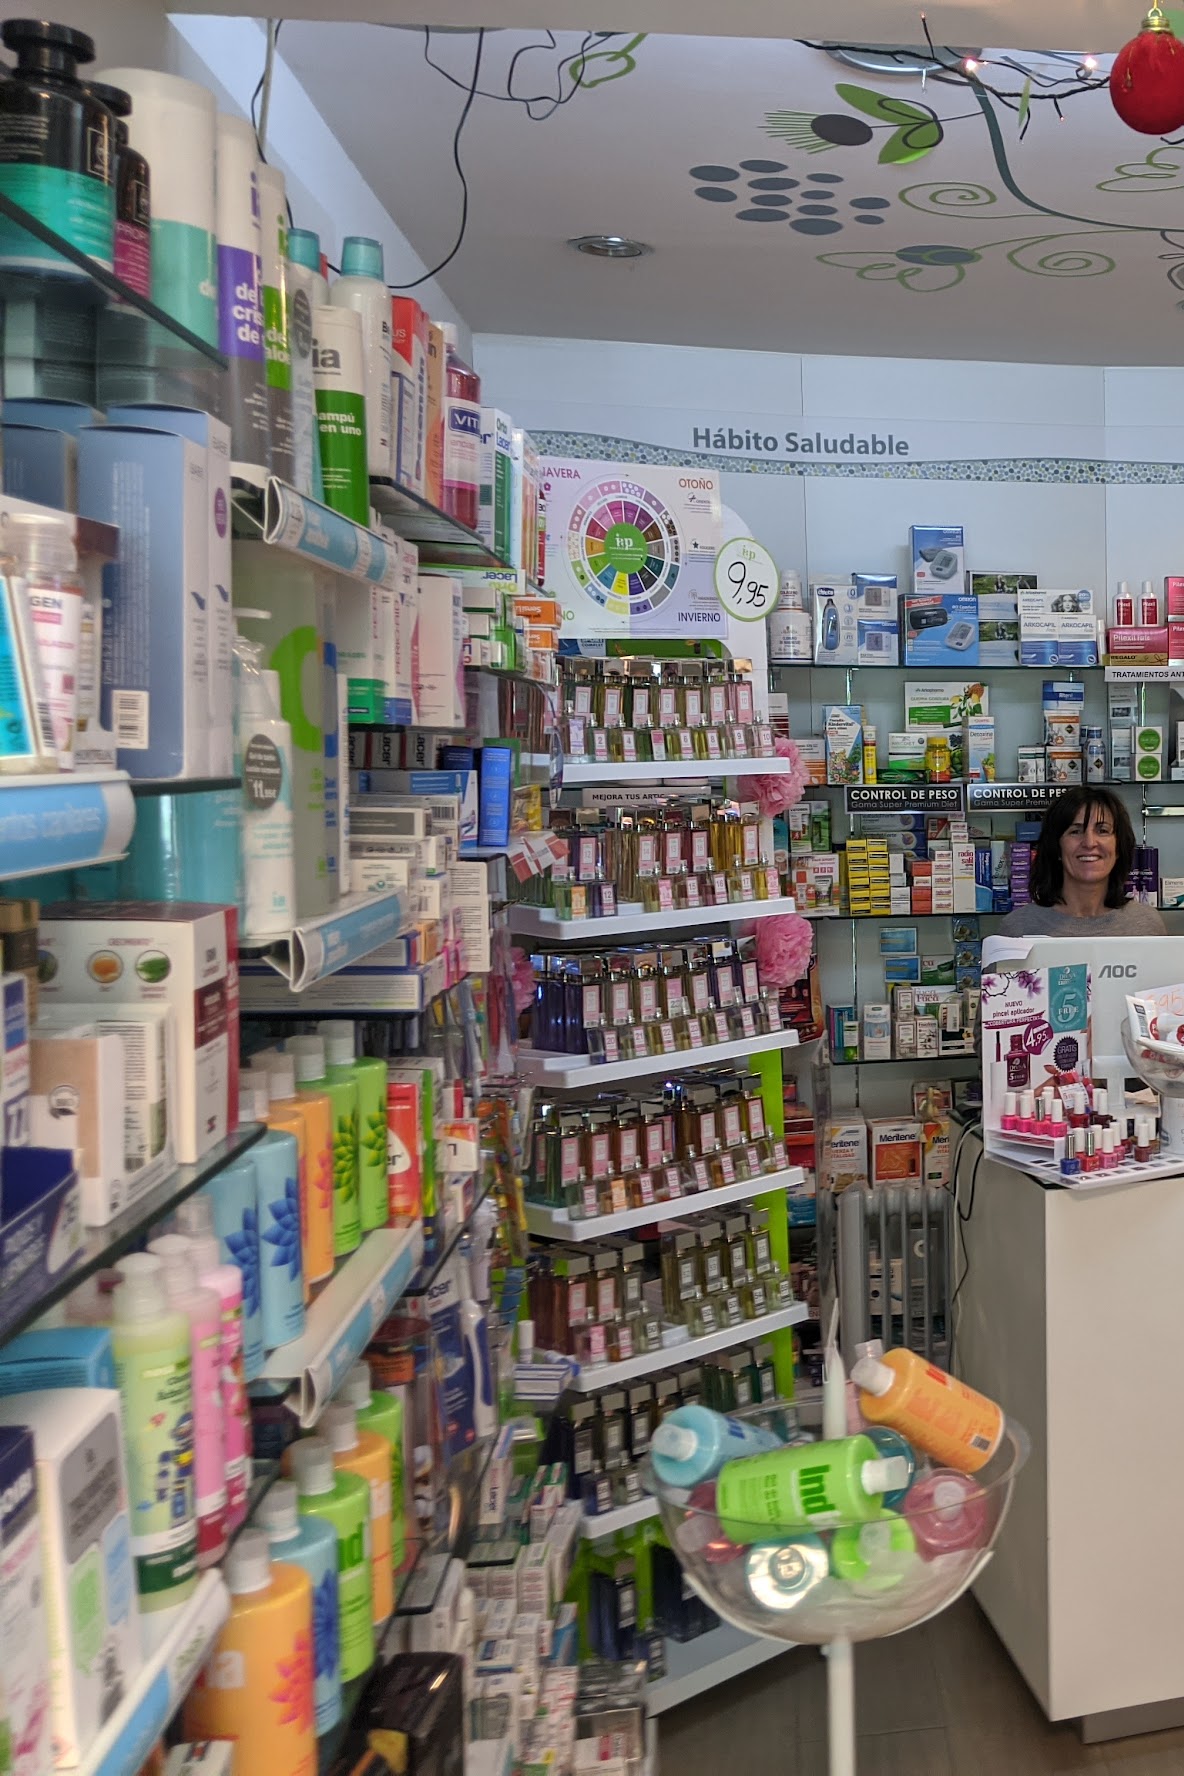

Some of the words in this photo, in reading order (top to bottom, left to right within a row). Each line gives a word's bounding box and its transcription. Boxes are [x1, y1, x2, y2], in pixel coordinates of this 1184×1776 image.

[693, 427, 778, 452] Hábito
[785, 432, 910, 456] Saludable
[679, 477, 713, 490] OTOÑO
[728, 561, 769, 607] 9,95
[678, 612, 721, 623] INVIERNO
[592, 793, 623, 801] MEJORA
[624, 793, 640, 801] TUS
[851, 790, 908, 800] CONTROL
[910, 790, 925, 800] DE
[929, 789, 957, 799] PESO
[974, 788, 1029, 798] CONTROL
[1032, 788, 1046, 797] DE
[851, 801, 877, 810] Gama
[879, 801, 904, 810] Super
[906, 800, 939, 809] Premium
[974, 799, 999, 808] Gama
[1001, 799, 1024, 808] Super
[1098, 965, 1138, 979] AOC
[879, 1133, 916, 1142] Meritene
[831, 1139, 860, 1148] eritene
